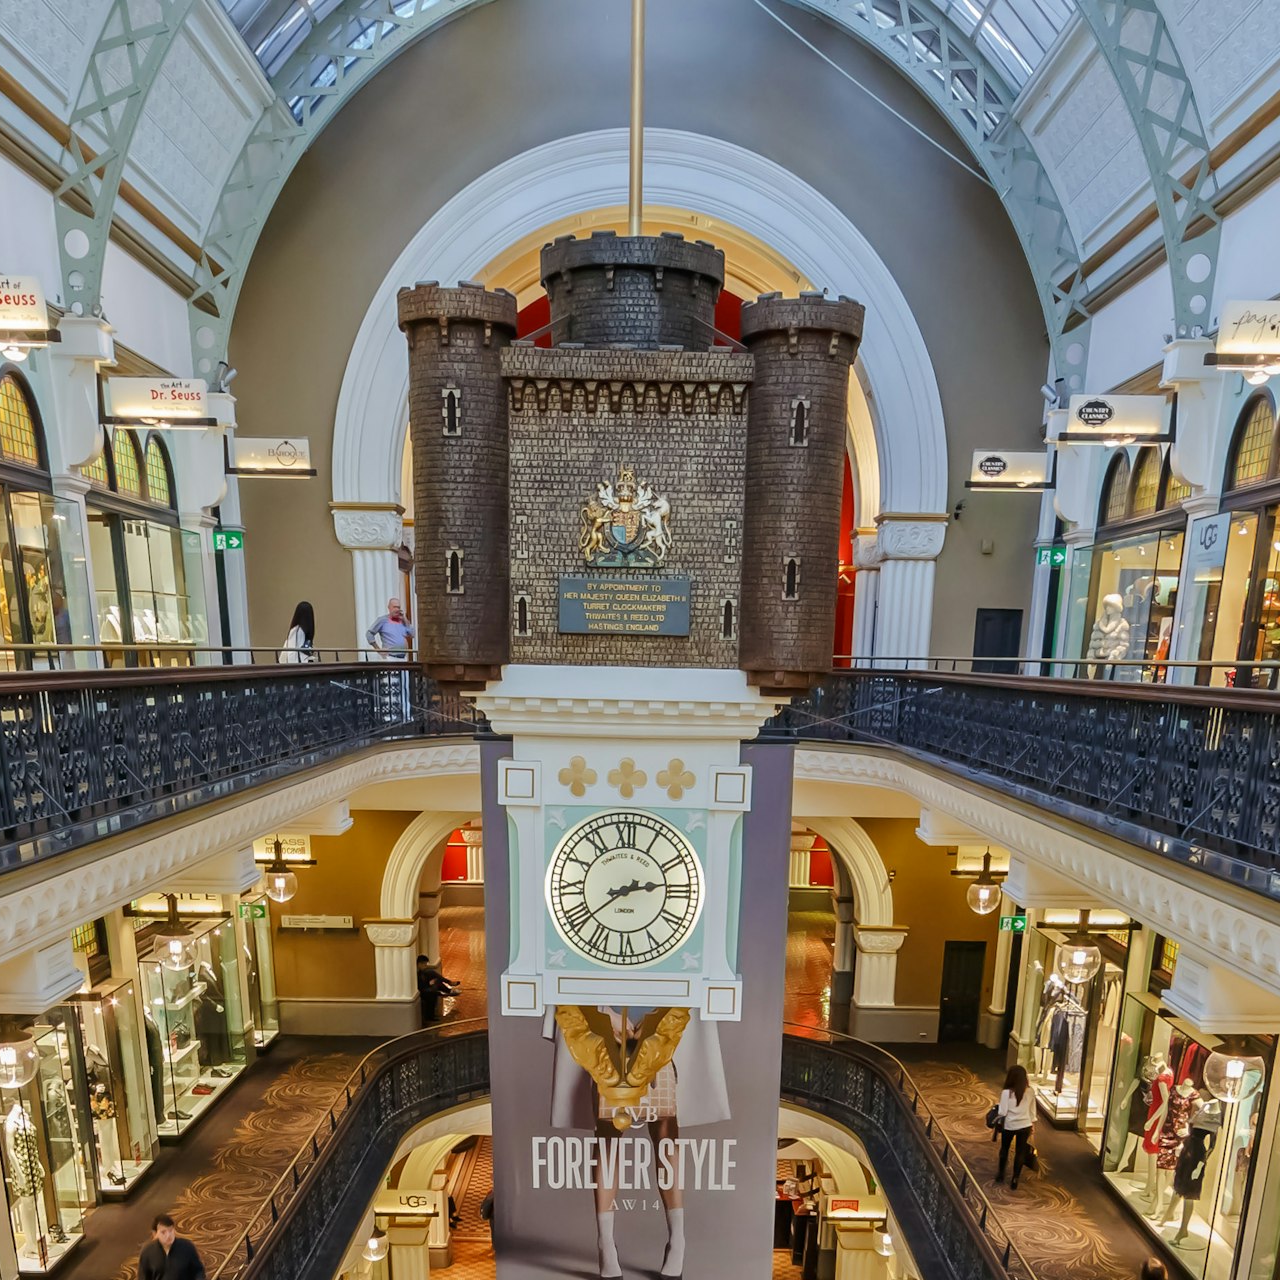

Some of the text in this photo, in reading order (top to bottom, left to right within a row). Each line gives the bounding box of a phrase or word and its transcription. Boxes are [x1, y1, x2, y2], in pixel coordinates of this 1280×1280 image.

[171, 381, 183, 389] Art
[150, 389, 201, 401] Dr. Seuss
[1200, 523, 1218, 550] UGG
[599, 583, 649, 592] APPOINTMENT
[651, 584, 661, 592] TO
[615, 593, 640, 601] QUEEN
[641, 594, 680, 602] ELIZABETH
[583, 602, 667, 612] TURRET CLOCKMAKERS
[585, 612, 621, 620] THWAITES
[650, 614, 665, 622] LTD
[588, 623, 660, 631] HASTINGS ENGLAND
[264, 838, 306, 846] CASS
[601, 852, 629, 867] THWAITES
[636, 855, 651, 869] REED
[531, 1135, 738, 1192] FOREVER STYLE
[399, 1195, 428, 1208] UGG
[608, 1199, 661, 1211] AW14
